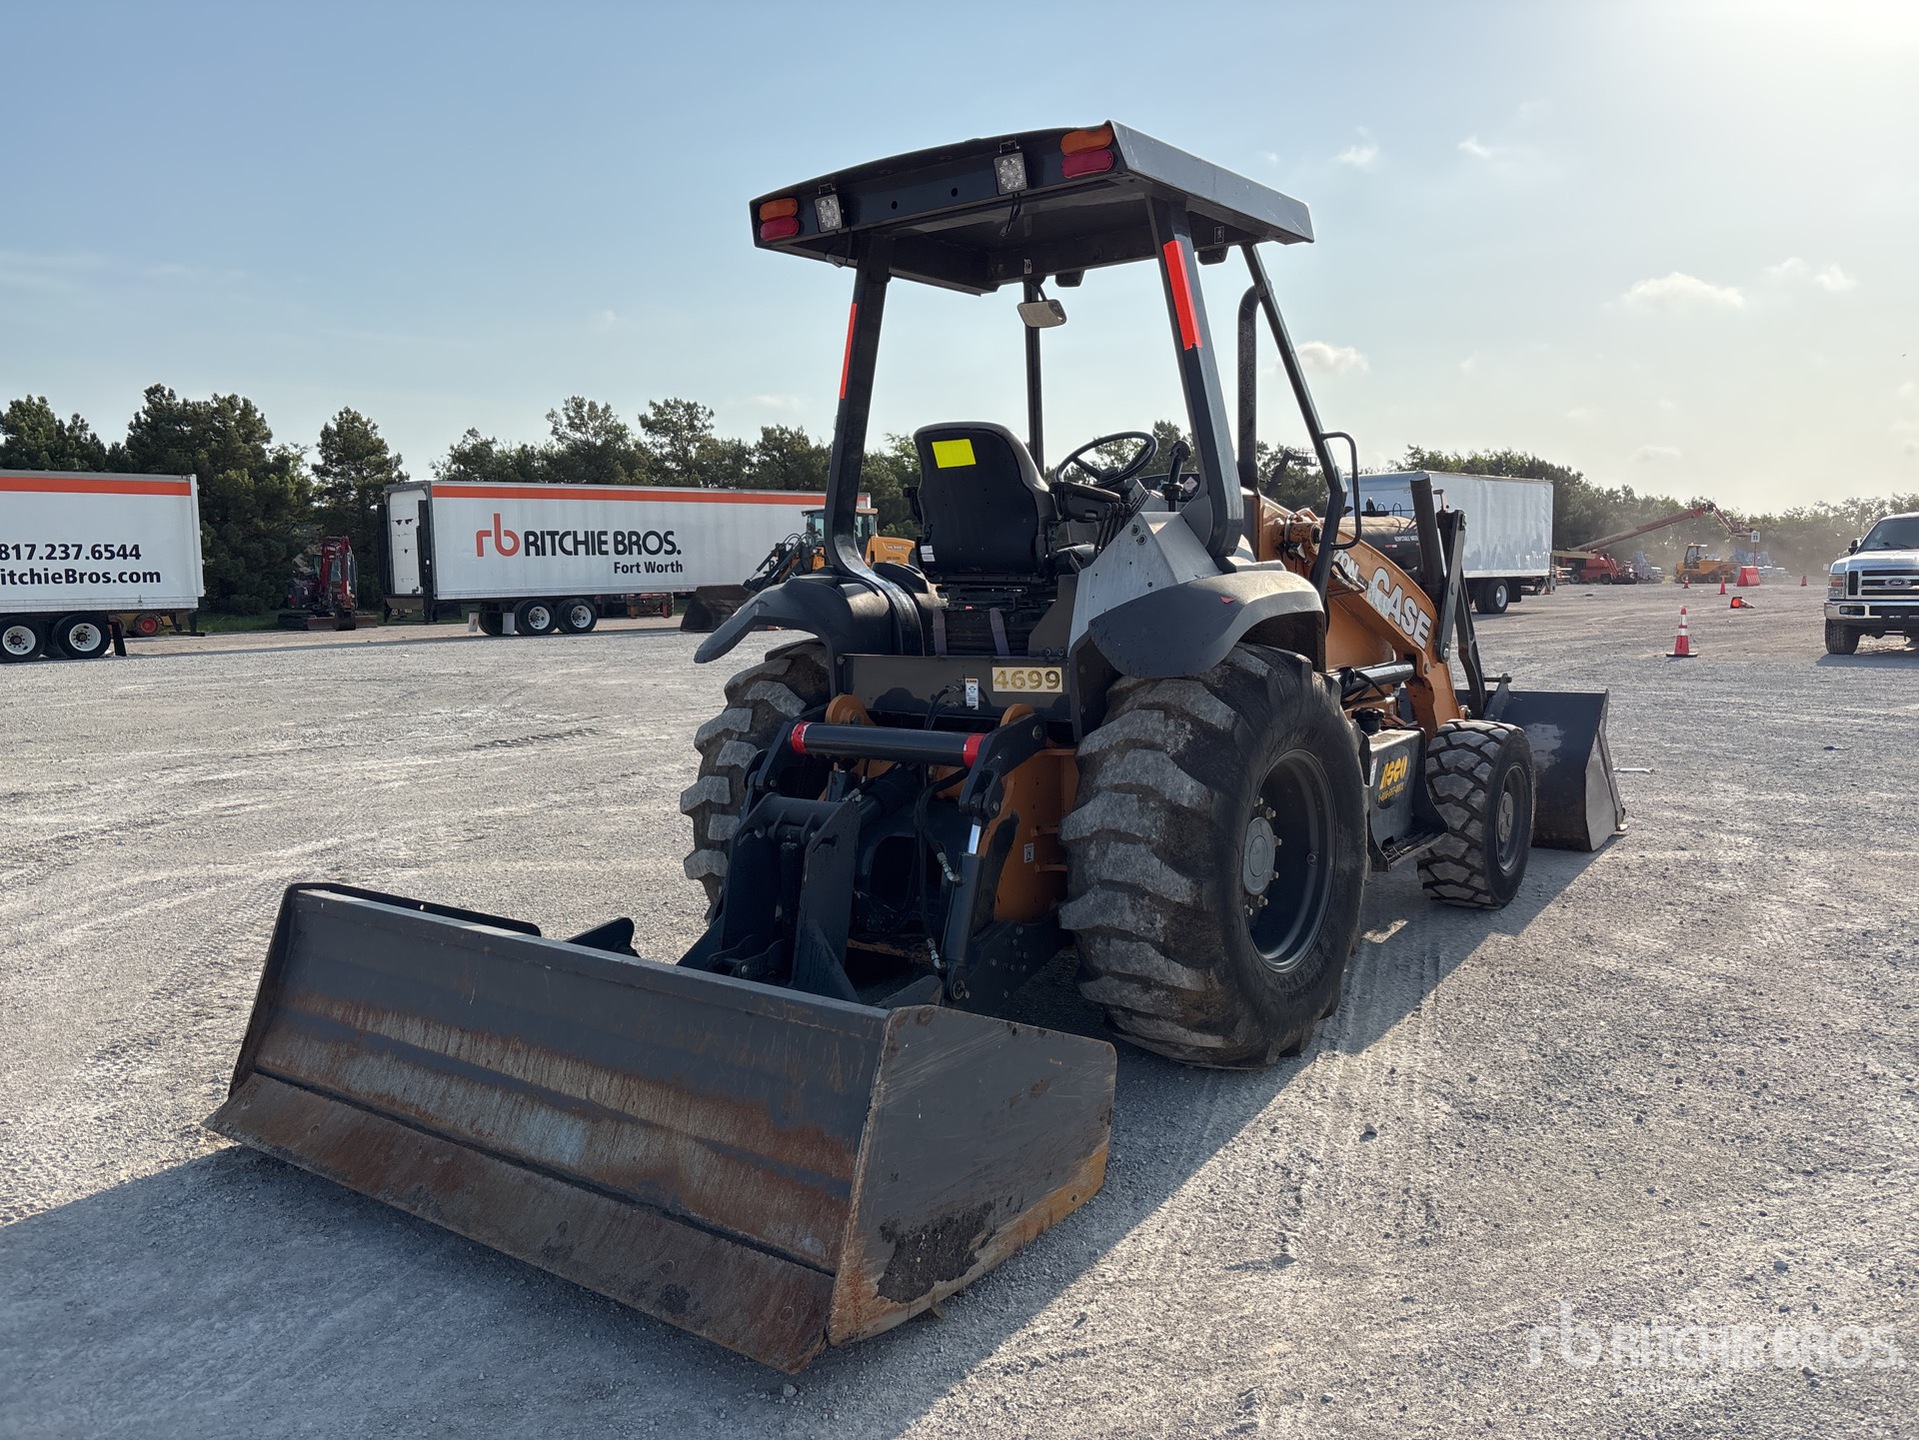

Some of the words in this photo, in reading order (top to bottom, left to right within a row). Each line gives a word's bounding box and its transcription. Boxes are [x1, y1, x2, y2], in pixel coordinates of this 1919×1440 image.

[476, 513, 520, 557] rb
[524, 530, 609, 557] RITCHIE
[613, 530, 682, 556] BROS.
[0, 544, 142, 561] 817.237.6544
[614, 561, 641, 574] Fort
[644, 560, 683, 574] Worth
[1371, 566, 1432, 650] CASE
[994, 670, 1060, 690] 4699
